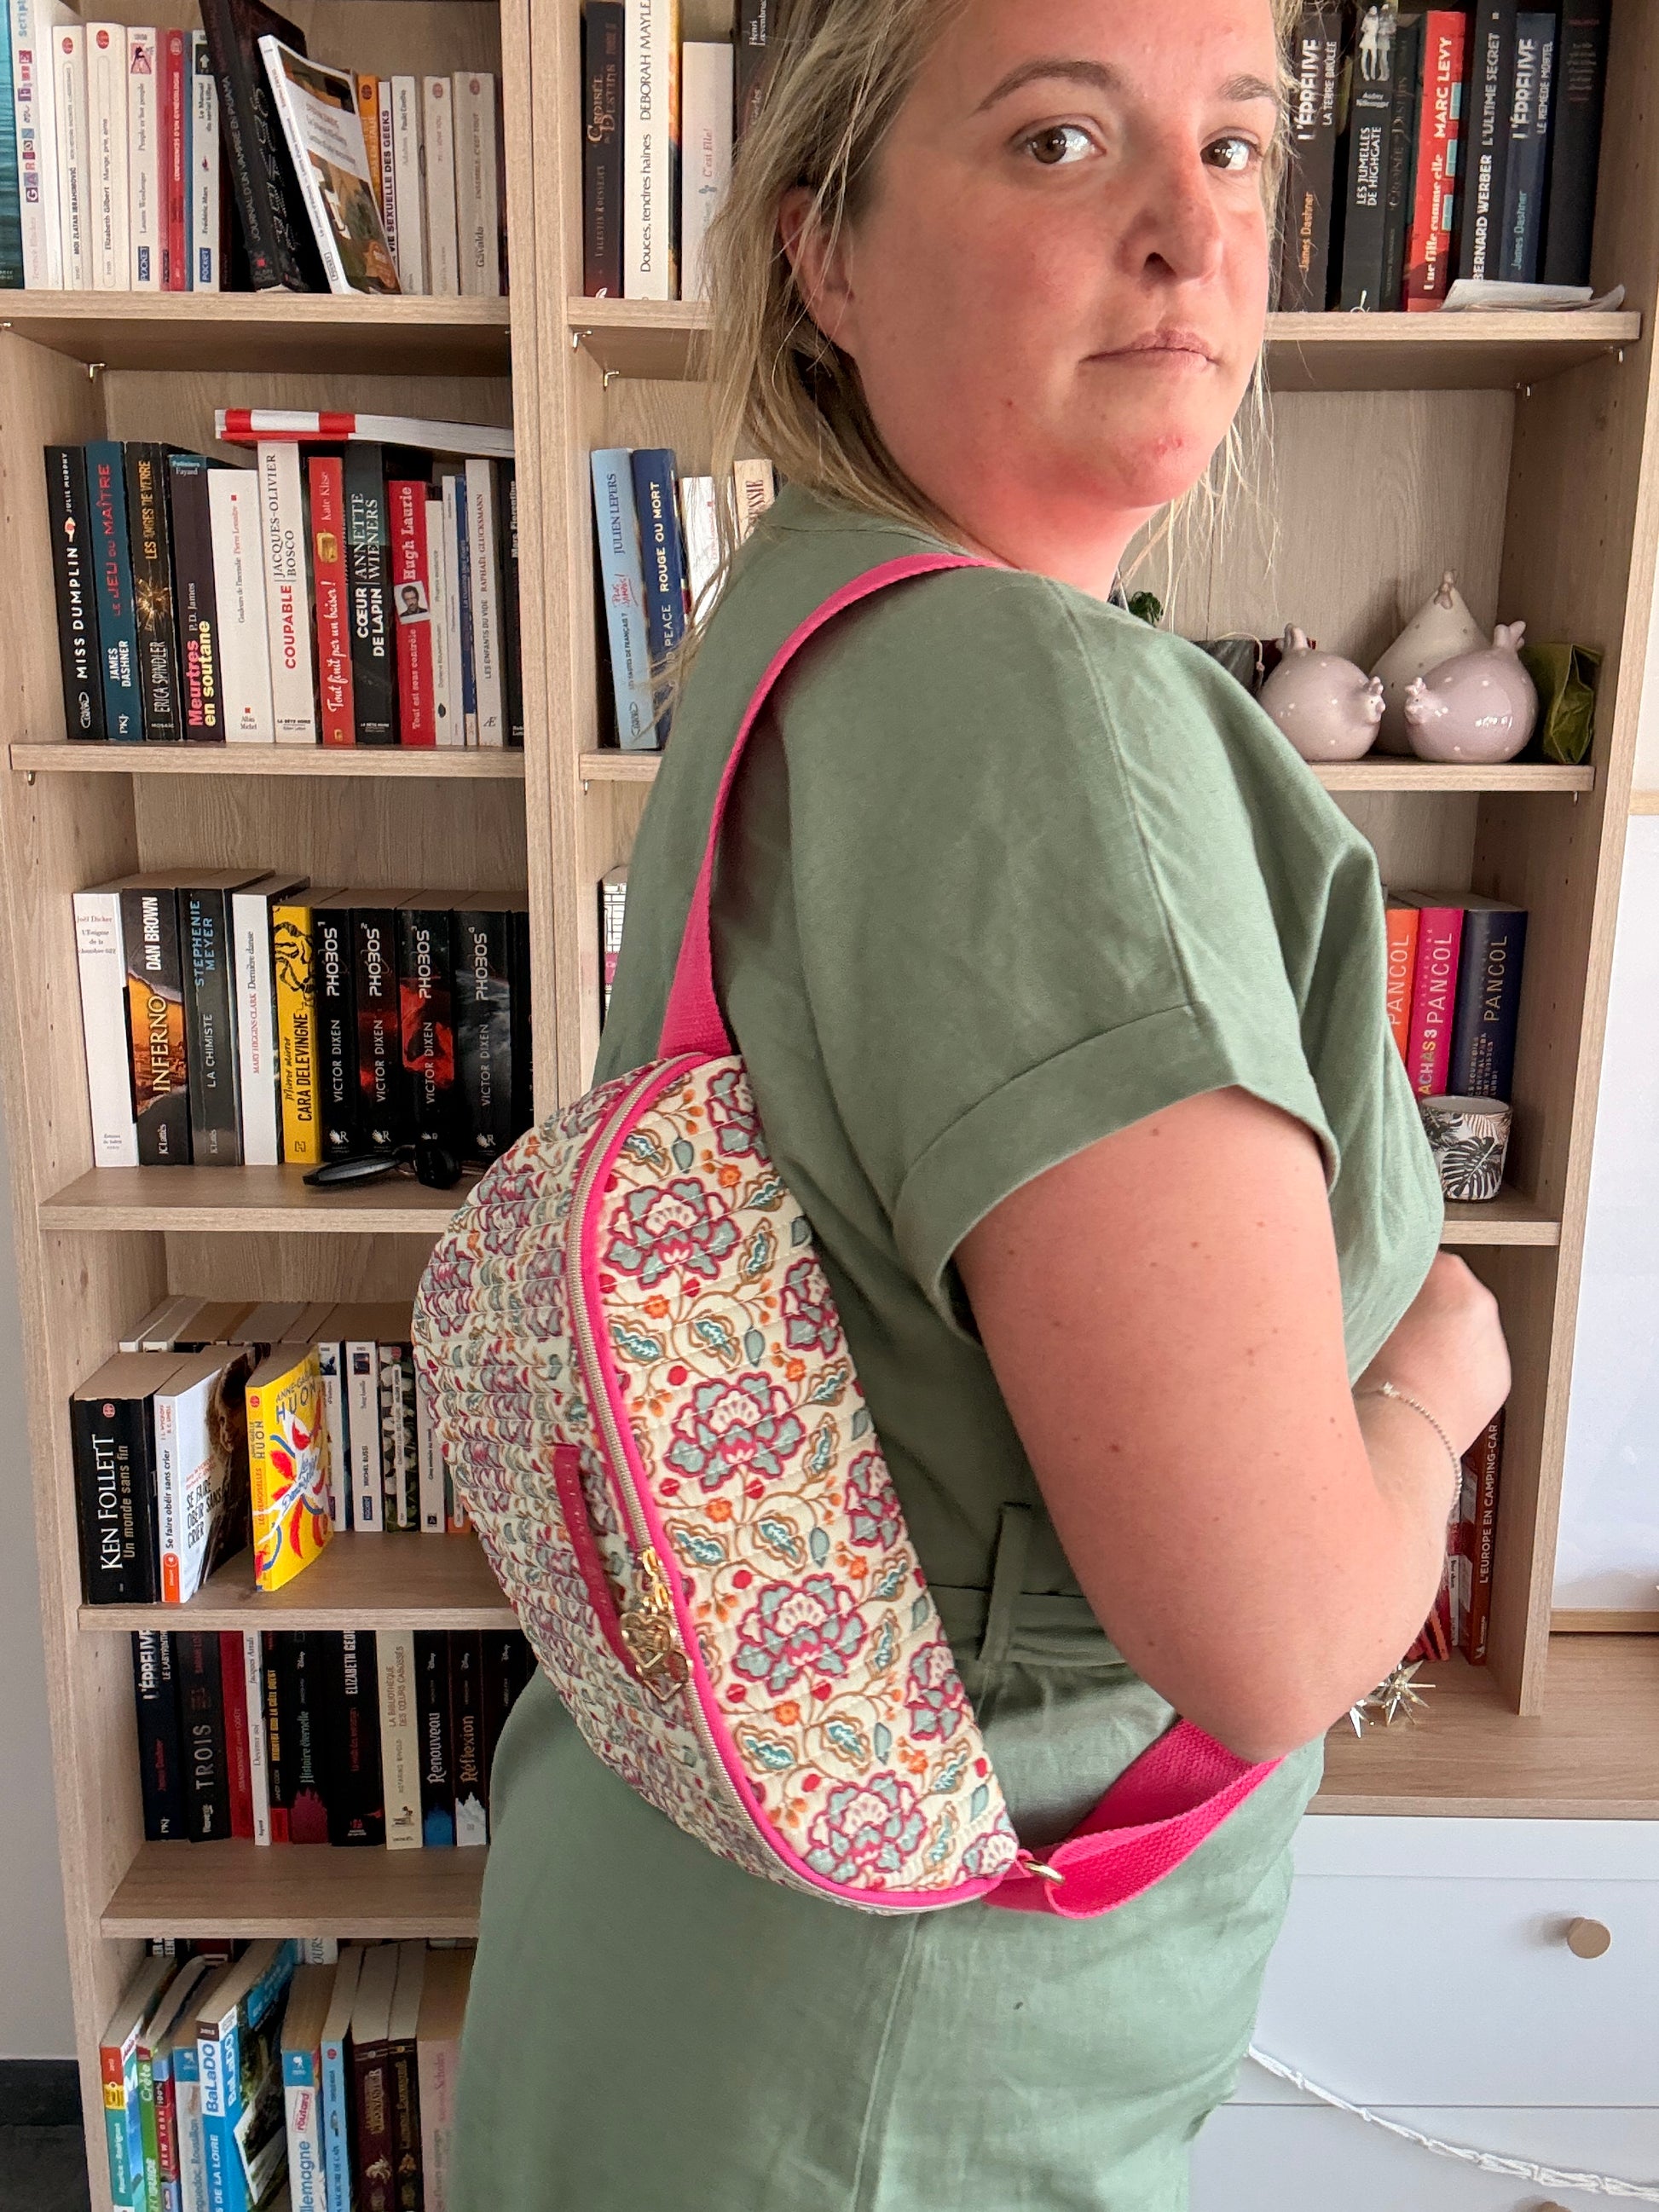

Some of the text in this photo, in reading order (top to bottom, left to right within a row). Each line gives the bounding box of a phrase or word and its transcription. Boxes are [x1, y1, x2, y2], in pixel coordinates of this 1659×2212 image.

[639, 55, 651, 121] DEBORAH
[1322, 113, 1332, 125] LA
[1434, 36, 1452, 137] MARC LEVY
[1481, 32, 1500, 146] L'ULTIME SECRET
[1535, 40, 1553, 134] LE MORTEL
[381, 109, 394, 233] SEXUELLE DES GEEKS
[702, 153, 714, 177] C'est
[1356, 126, 1370, 205] LES JUMELLES
[1367, 126, 1381, 205] DE HIGHGATE
[101, 187, 112, 251] Elizabeth Gilbert
[640, 133, 652, 273] Douces, tendres haines
[1299, 191, 1315, 273] James Dashner
[1424, 153, 1444, 262] fille comme elle
[1472, 154, 1492, 280] BERNARD WERBER
[1511, 190, 1527, 271] James Dashner
[138, 247, 149, 280] POCKET
[201, 249, 210, 280] POCKET
[474, 226, 485, 268] Gavalda
[61, 452, 72, 513] JULIE MURPHY
[138, 460, 159, 559] LES DE VERRE
[265, 454, 285, 578] JACQUES-OLIVIER
[318, 471, 332, 521] Kate Klise
[606, 472, 625, 555] JULIEN LEPERS
[96, 463, 122, 616] LE JEU DU MAÎTRE
[284, 529, 297, 577] BOSCO
[350, 493, 367, 580] ANNETTE
[364, 499, 380, 578] WIENERS
[400, 487, 418, 580] Hugh Laurie
[476, 494, 488, 592] RAPHAËL GLUCKSMANN
[650, 481, 669, 592] ROUGE OU MORT
[66, 546, 84, 631] DUMPLIN
[188, 582, 198, 609] James
[356, 587, 369, 638] CŒUR
[370, 587, 385, 657] DE LAPIN
[480, 599, 489, 617] VIDE
[482, 618, 490, 628] DU
[661, 604, 674, 647] PEACE
[73, 638, 88, 679] MISS
[118, 640, 131, 687] DASHNER
[280, 584, 297, 669] COUPABLE
[322, 589, 349, 713] Tout finit par un baiser
[483, 630, 492, 664] ENFANTS
[107, 648, 119, 681] JAMES
[149, 641, 171, 713] ERICA SPINDLER
[187, 640, 204, 727] Meurtres
[198, 621, 216, 727] en soutane
[407, 629, 421, 730] Tout est sous contrôle
[142, 897, 162, 971] DAN BROWN
[190, 899, 205, 987] STEPHENIE
[203, 917, 216, 971] MEYER
[246, 931, 257, 990] Dernière danse
[324, 927, 340, 996] PHOBOS
[366, 927, 382, 996] PHOBOS
[416, 930, 432, 999] PHOBOS
[472, 933, 488, 1001] PHOBOS
[1387, 934, 1410, 1025] PANCOL
[1426, 933, 1453, 1024] PANCOL
[1483, 935, 1508, 1021] PANCOL
[147, 996, 171, 1092] INFERNO
[203, 1014, 217, 1088] LA CHIMISTE
[248, 993, 260, 1074] MARY HIGGINS CLARK
[292, 1014, 312, 1122] CARA DELEVINGNE
[330, 1019, 344, 1103] VICTOR DIXEN
[373, 1019, 387, 1103] VICTOR DIXEN
[422, 1021, 436, 1104] VICTOR DIXEN
[478, 1024, 492, 1106] VICTOR DIXEN
[255, 1420, 265, 1459] HUON
[91, 1433, 124, 1570] KEN FOLLETT
[116, 1444, 136, 1558] Un monde sans fin
[162, 1449, 174, 1549] Se faire obéir sans crier
[1479, 1424, 1499, 1584] L'EUROPE EN CAMPING-CAR
[163, 1671, 171, 1680] LE
[344, 1654, 358, 1695] ELIZABETH
[384, 1665, 396, 1727] LA BIBLIOTHÈQUE
[193, 1724, 215, 1790] TROIS
[296, 1711, 315, 1784] Histoire éternelle
[426, 1712, 447, 1784] Renouveau
[460, 1714, 478, 1783] Réflexion
[140, 2064, 153, 2102] Crète
[202, 2043, 219, 2113] BaLaDO
[297, 2093, 310, 2131] routard
[160, 2143, 169, 2166] NEW
[210, 2134, 223, 2204] DE LA LOIRE
